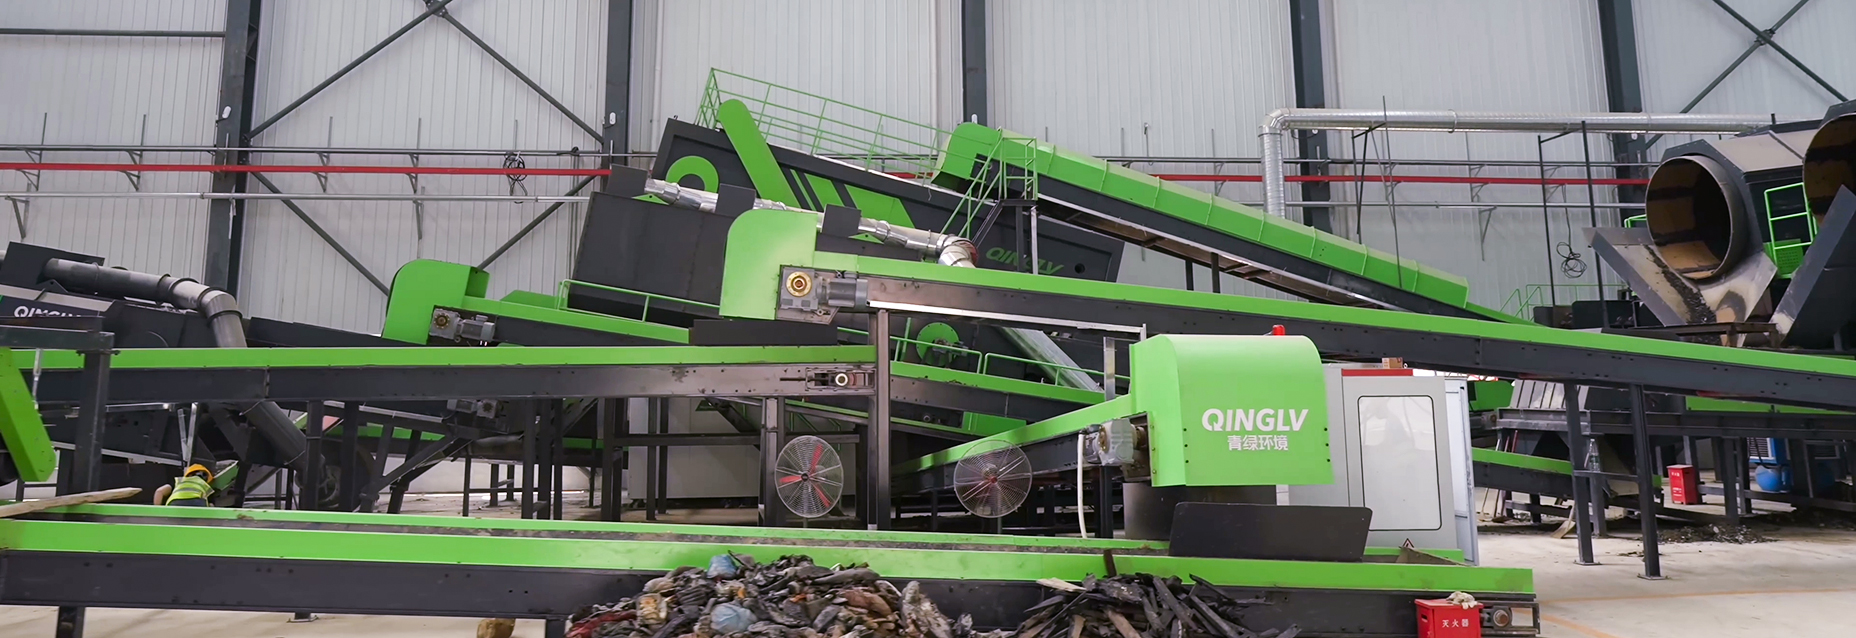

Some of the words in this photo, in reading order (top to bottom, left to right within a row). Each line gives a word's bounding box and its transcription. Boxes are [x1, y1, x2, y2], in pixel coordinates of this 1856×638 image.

[1202, 408, 1309, 431] QINGLV
[1227, 435, 1289, 451] 青绿环境
[1442, 619, 1469, 628] 灭火器
